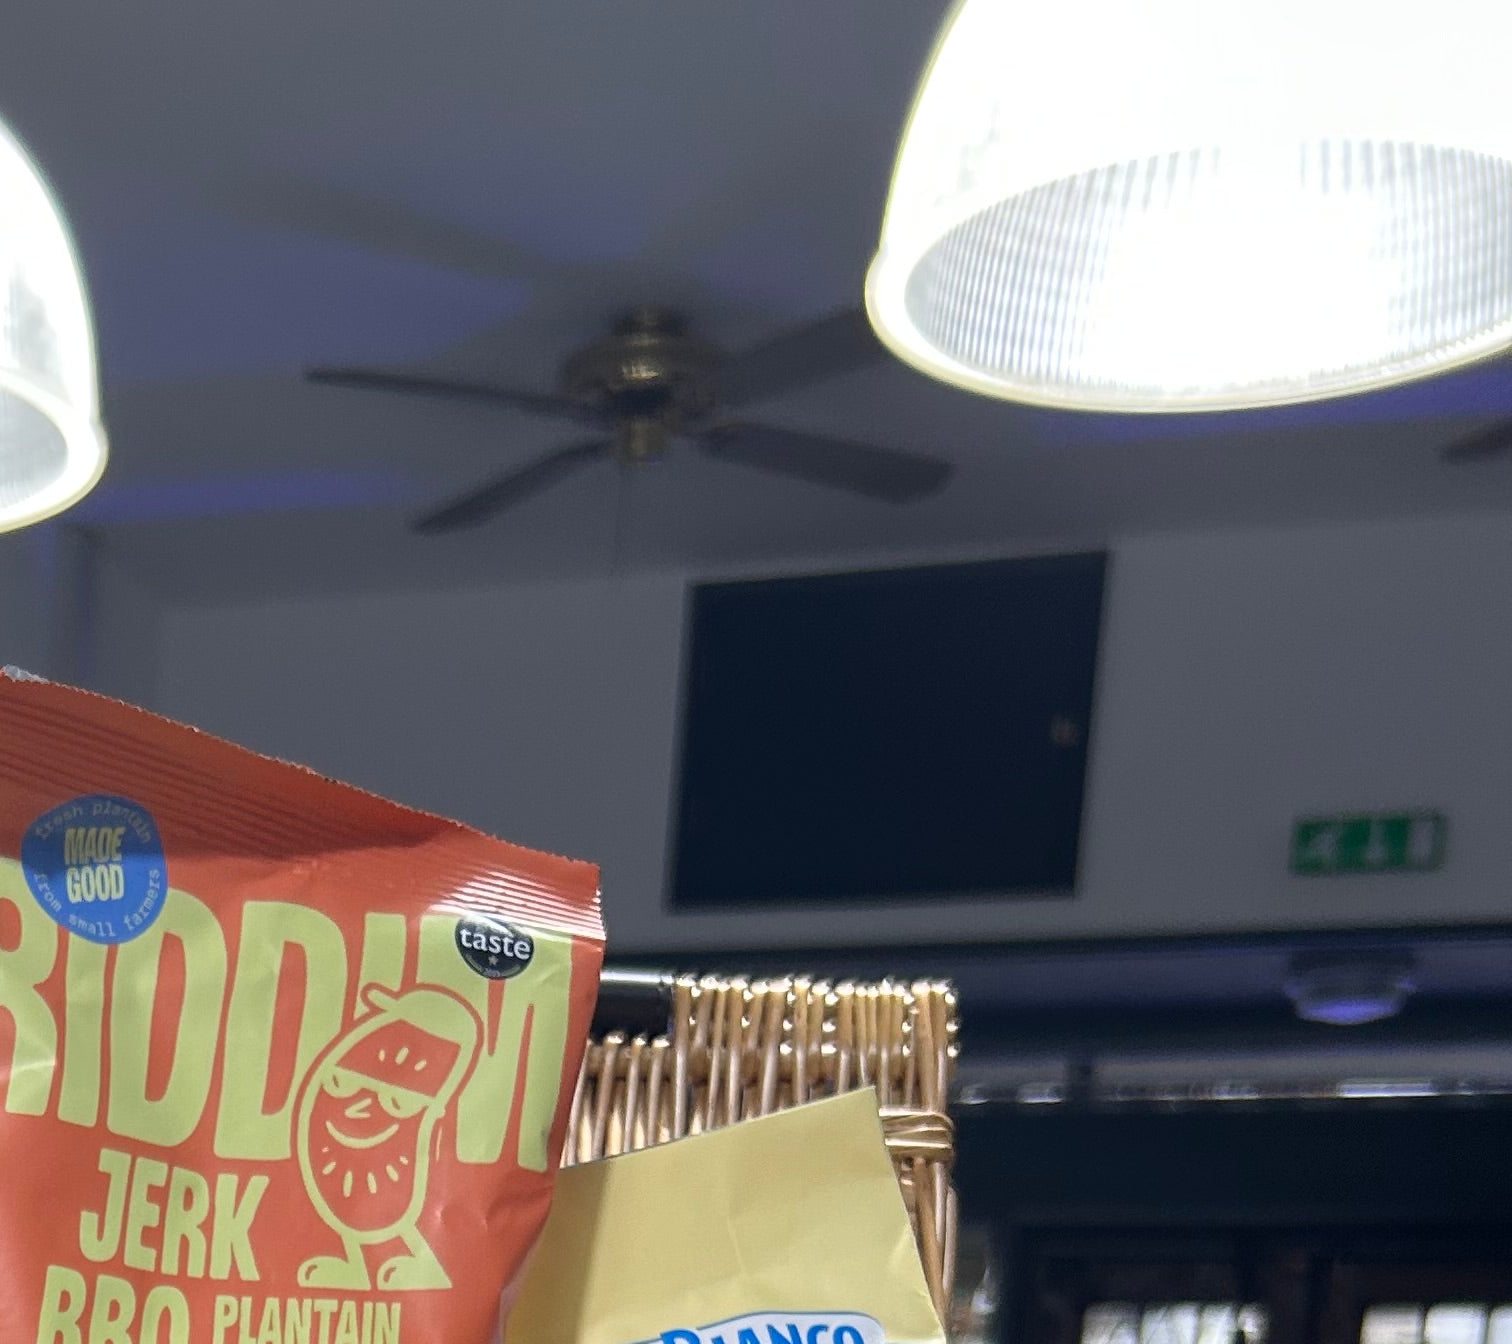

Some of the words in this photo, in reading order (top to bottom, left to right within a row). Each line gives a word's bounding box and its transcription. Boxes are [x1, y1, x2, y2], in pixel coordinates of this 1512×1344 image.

[64, 826, 126, 865] MADE
[33, 873, 62, 913] from
[68, 914, 116, 937] small
[123, 869, 161, 931] farmers
[66, 863, 125, 904] GOOD
[460, 928, 531, 960] taste
[79, 1148, 270, 1281] JERK
